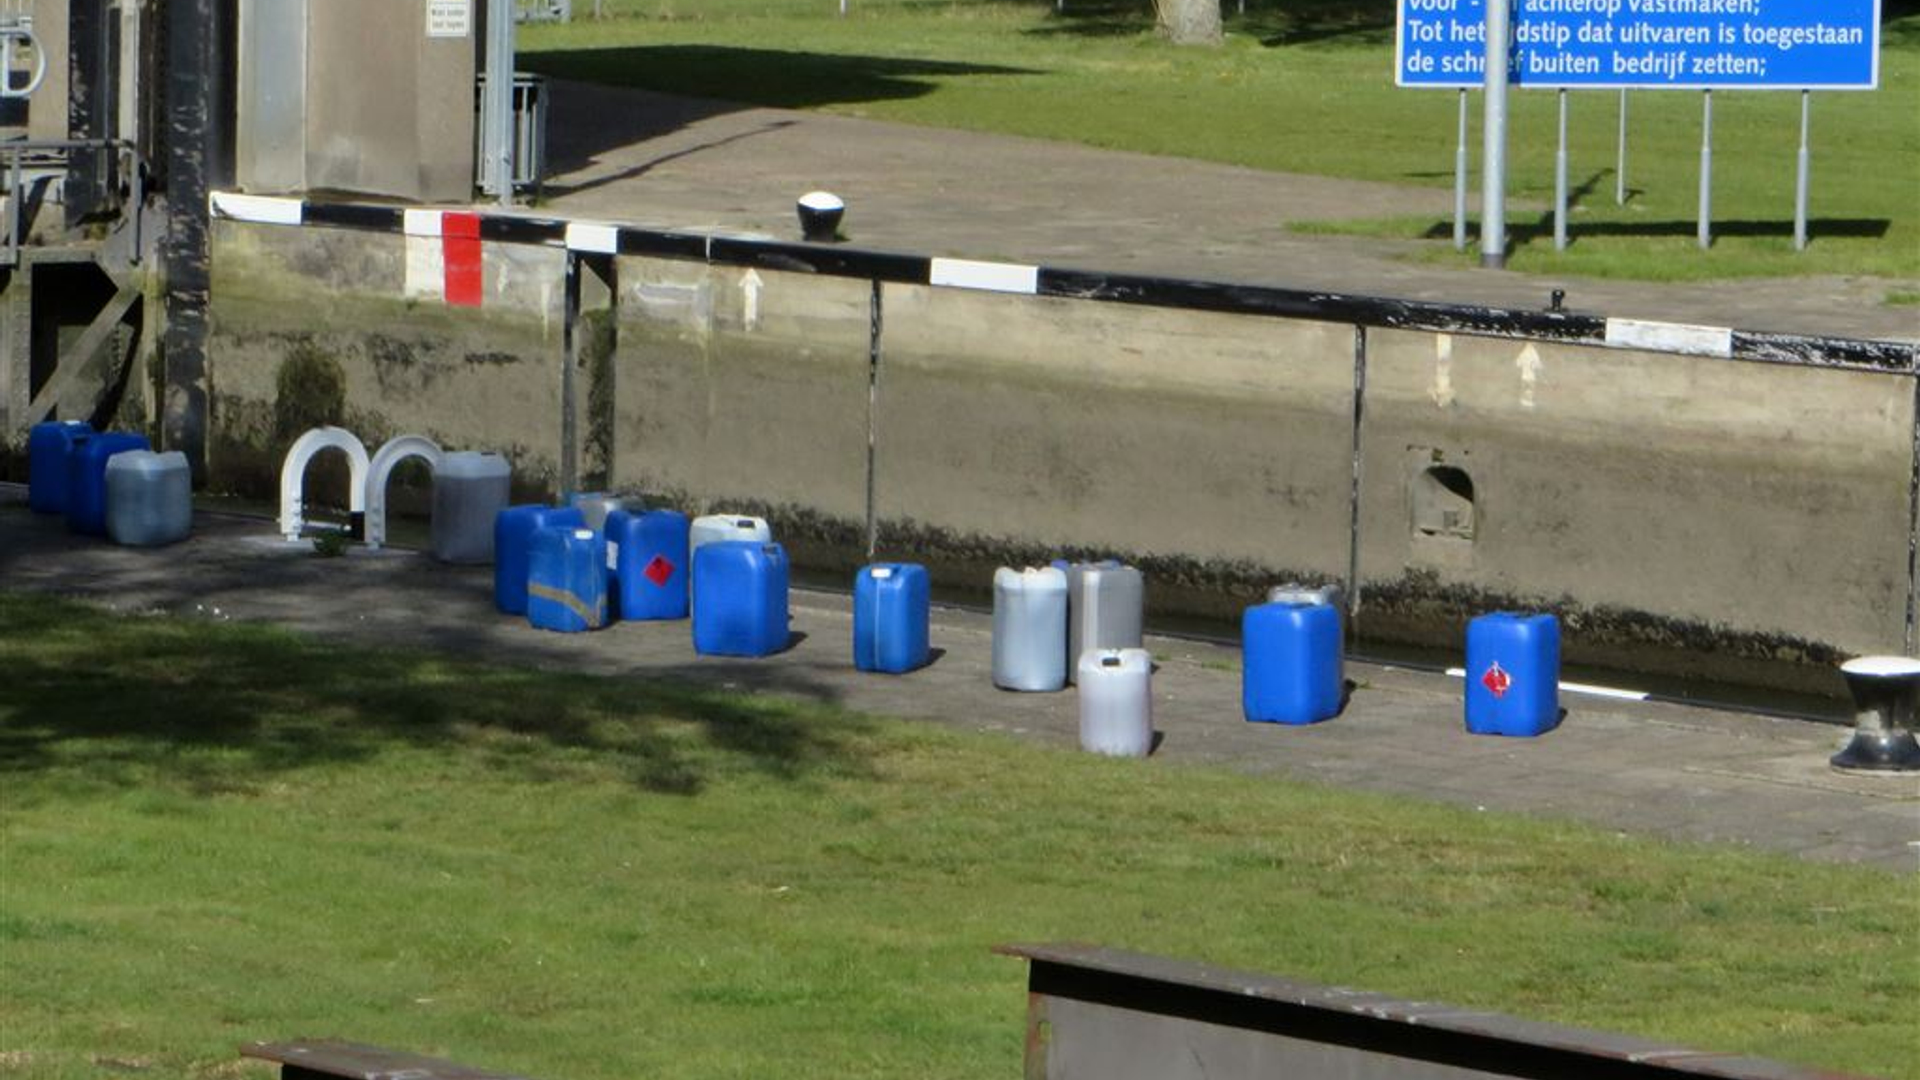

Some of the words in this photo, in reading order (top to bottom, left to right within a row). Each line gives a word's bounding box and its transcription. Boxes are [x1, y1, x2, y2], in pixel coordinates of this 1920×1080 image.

[1525, 0, 1621, 18] achterop
[1628, 0, 1760, 16] vastmaken;
[1409, 20, 1443, 42] Tot
[1451, 20, 1486, 42] het
[1507, 20, 1571, 49] jdstip
[1578, 21, 1613, 43] dat
[1621, 22, 1711, 44] uitvaren
[1719, 23, 1736, 44] is
[1743, 23, 1863, 50] toegestaan
[1407, 49, 1434, 72] de
[1531, 51, 1599, 73] buiten
[1614, 51, 1686, 80] bedrijf
[1693, 53, 1766, 76] zetten;
